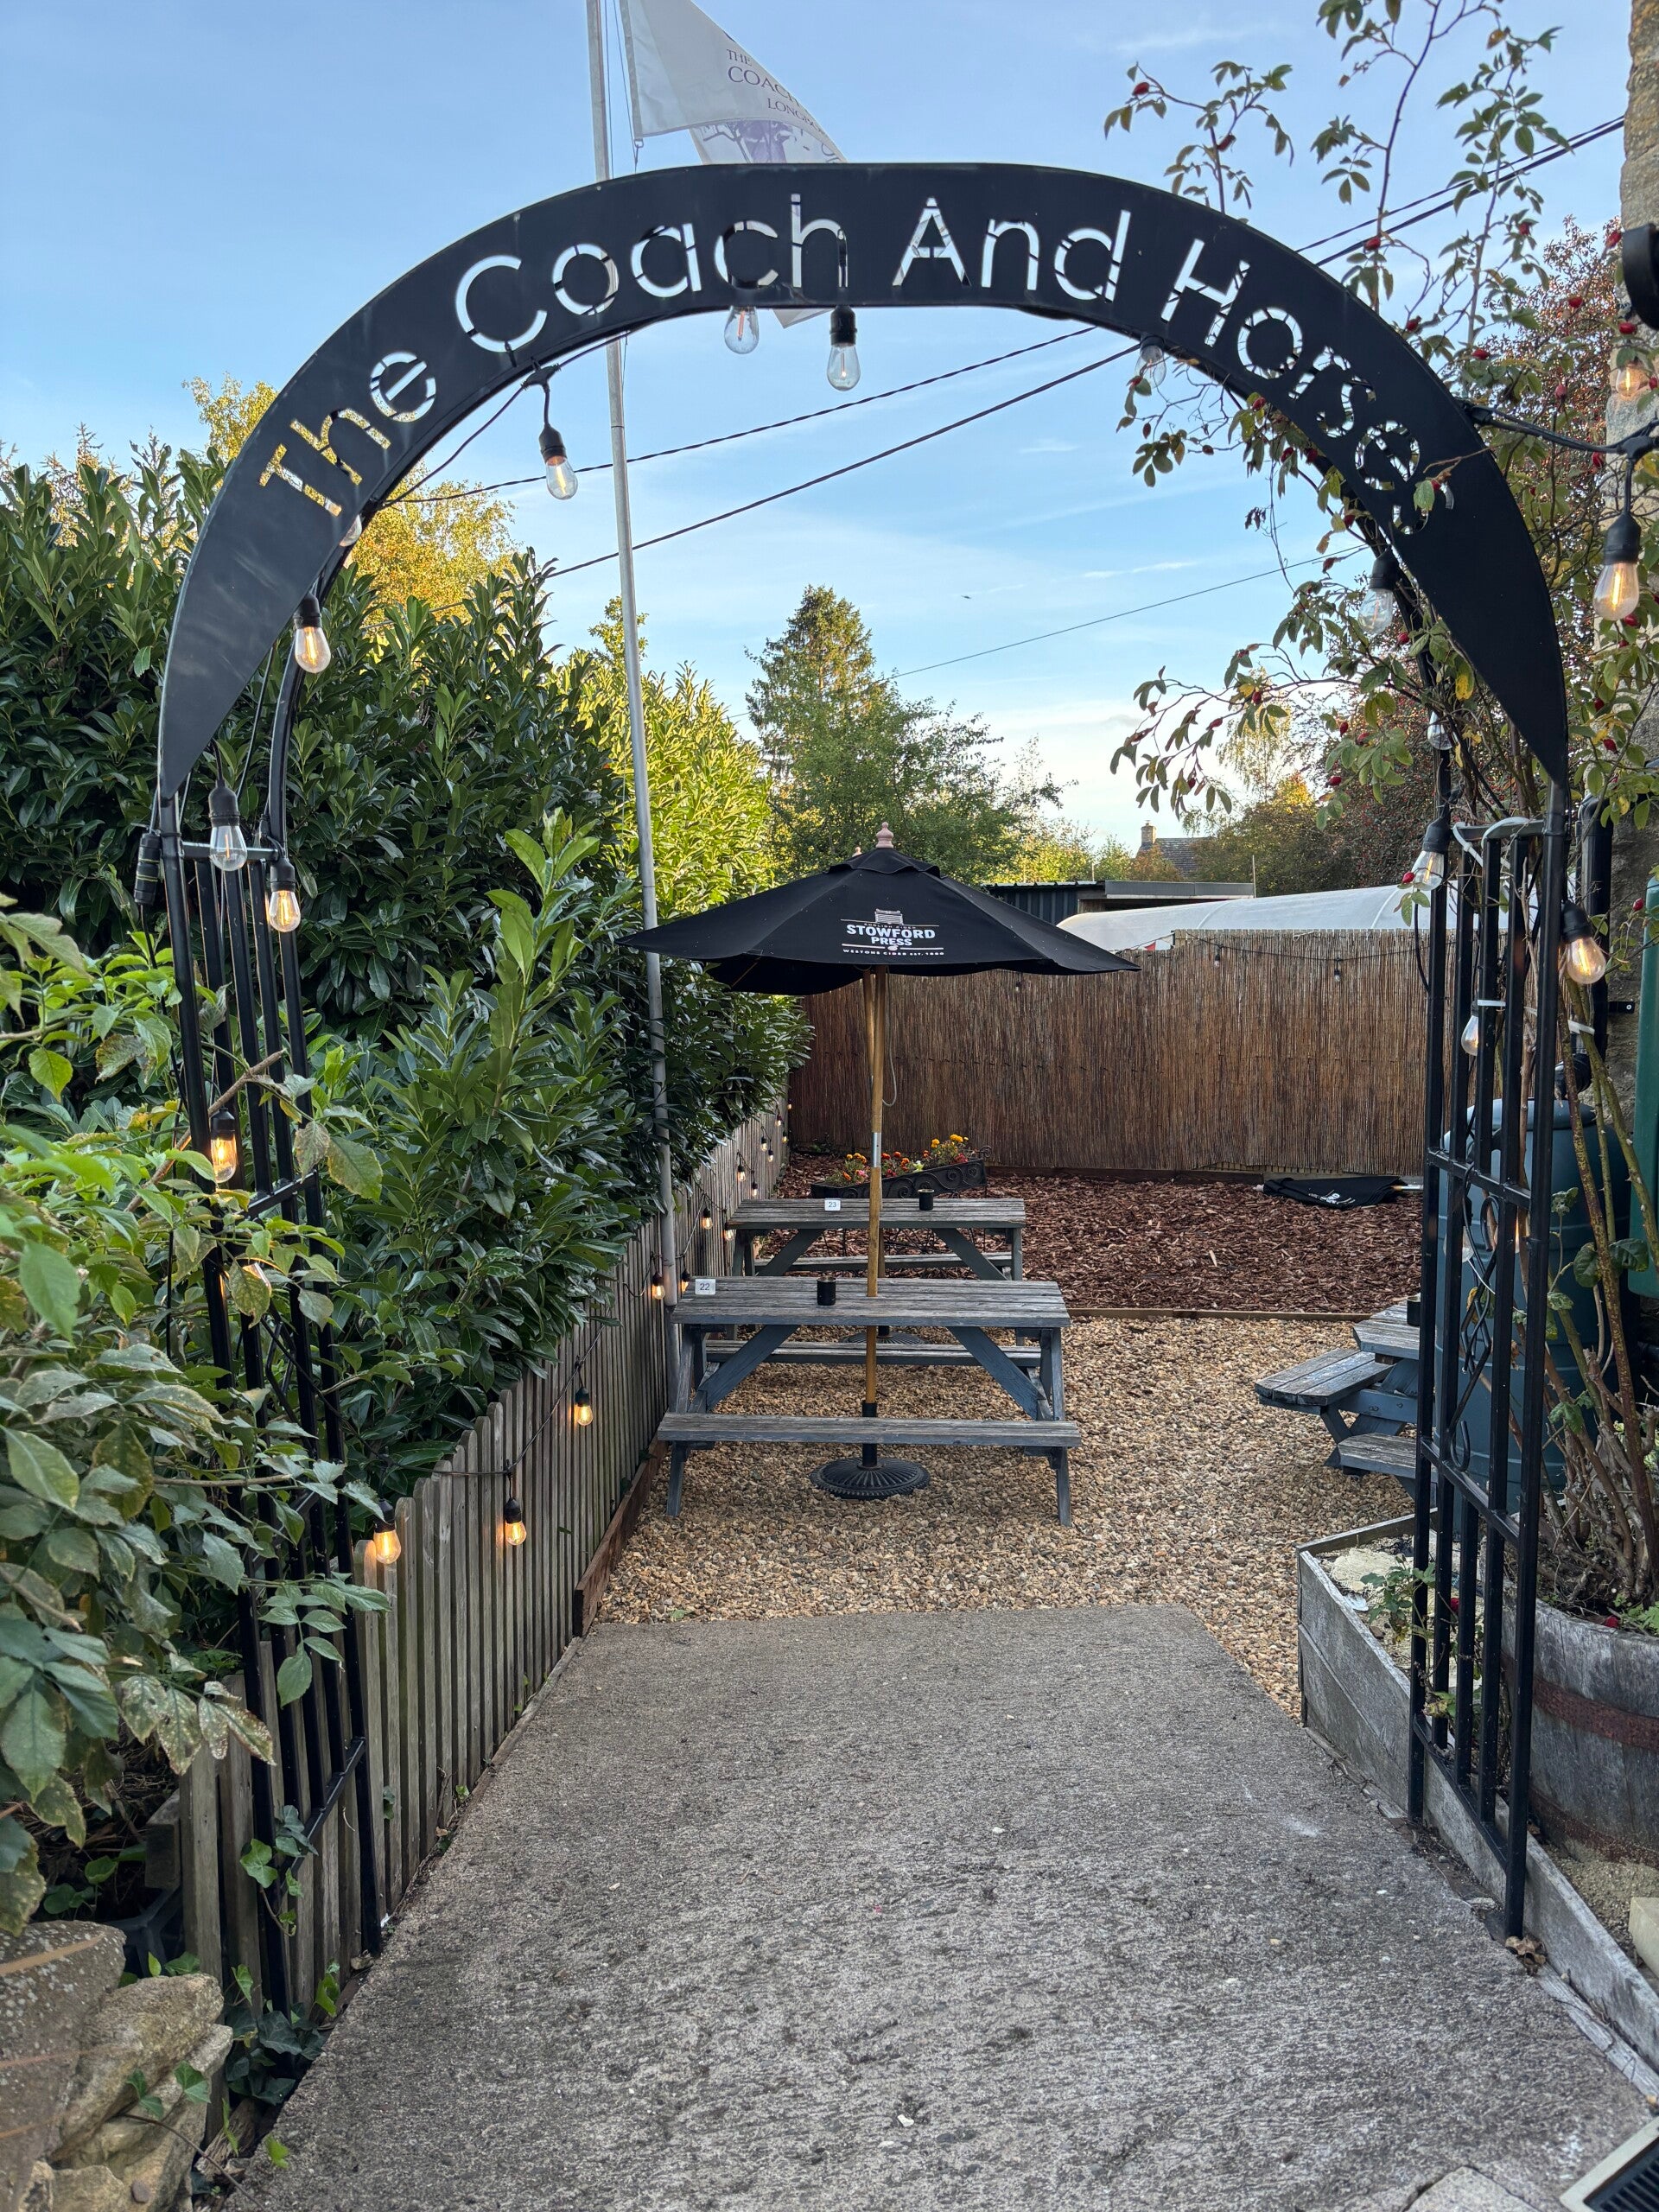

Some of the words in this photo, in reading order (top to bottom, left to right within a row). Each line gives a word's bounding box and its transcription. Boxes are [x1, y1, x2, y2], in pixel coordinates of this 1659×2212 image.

[726, 48, 753, 67] THE
[258, 351, 436, 516] The
[455, 193, 849, 353] Coach
[892, 197, 1130, 303] And
[846, 925, 935, 938] STOWFORD
[871, 937, 912, 945] PRESS
[699, 1282, 710, 1291] 22
